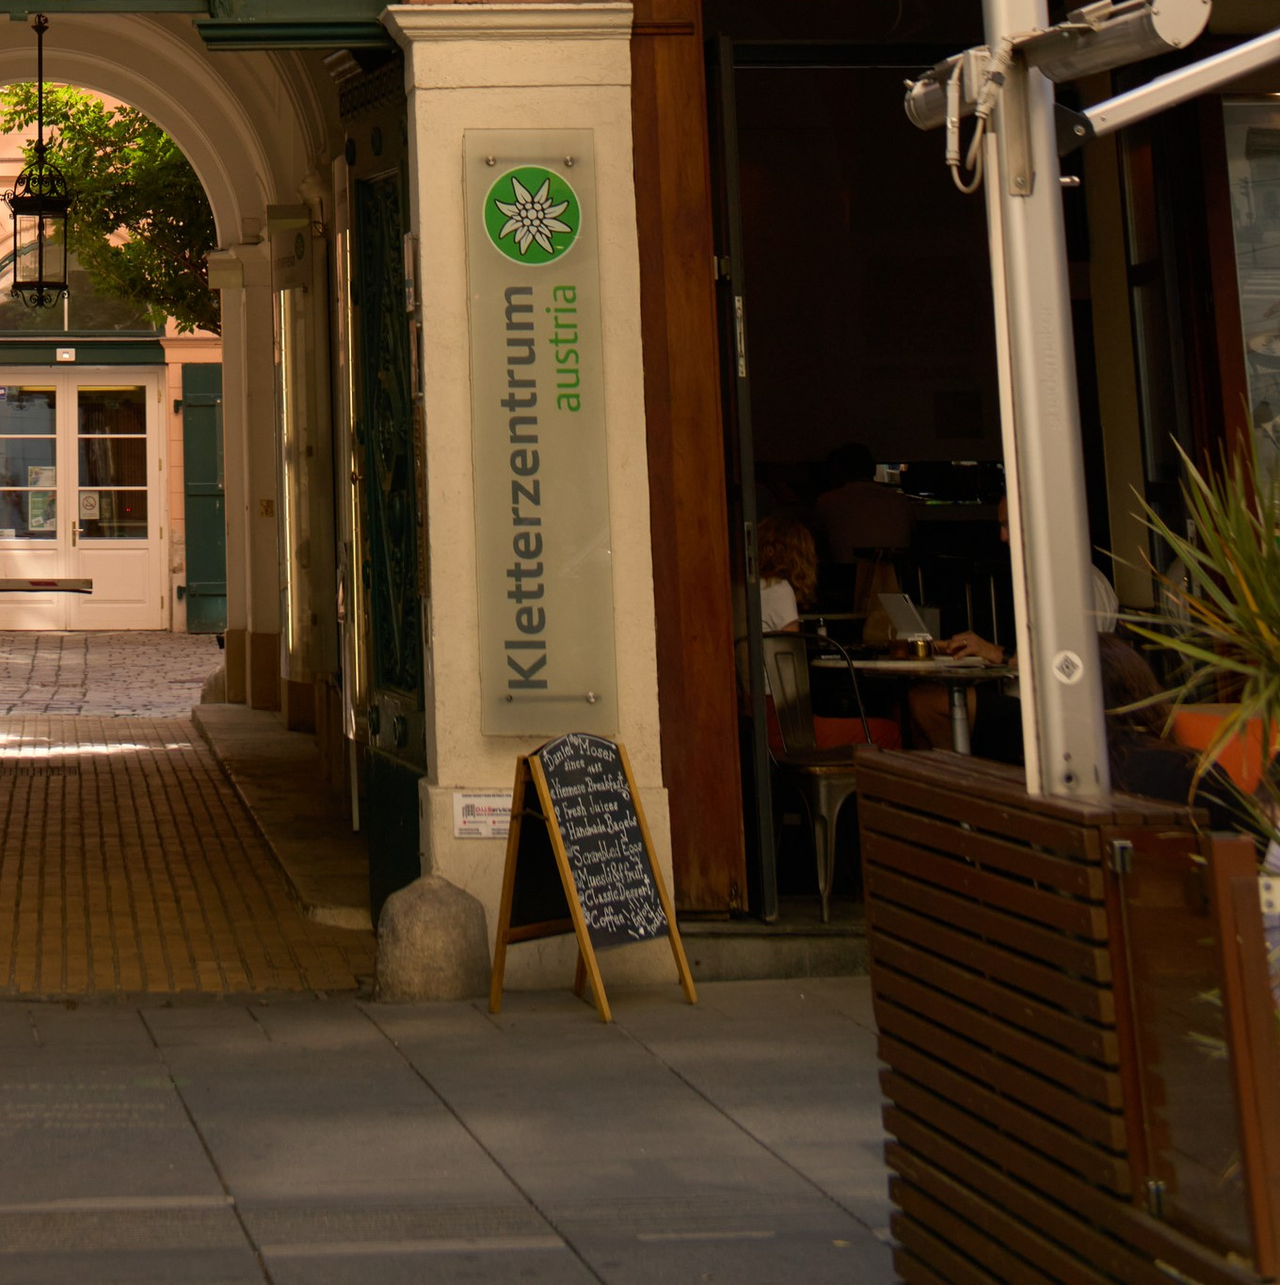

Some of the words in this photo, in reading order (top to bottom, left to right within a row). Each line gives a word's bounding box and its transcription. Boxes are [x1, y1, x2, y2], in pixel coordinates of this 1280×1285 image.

[544, 284, 581, 413] austria
[499, 285, 549, 691] Kletterzentrum
[578, 737, 616, 762] Moser
[564, 759, 586, 772] since
[562, 796, 588, 820] Fresh
[589, 794, 619, 815] Juices
[584, 885, 619, 906] Classic
